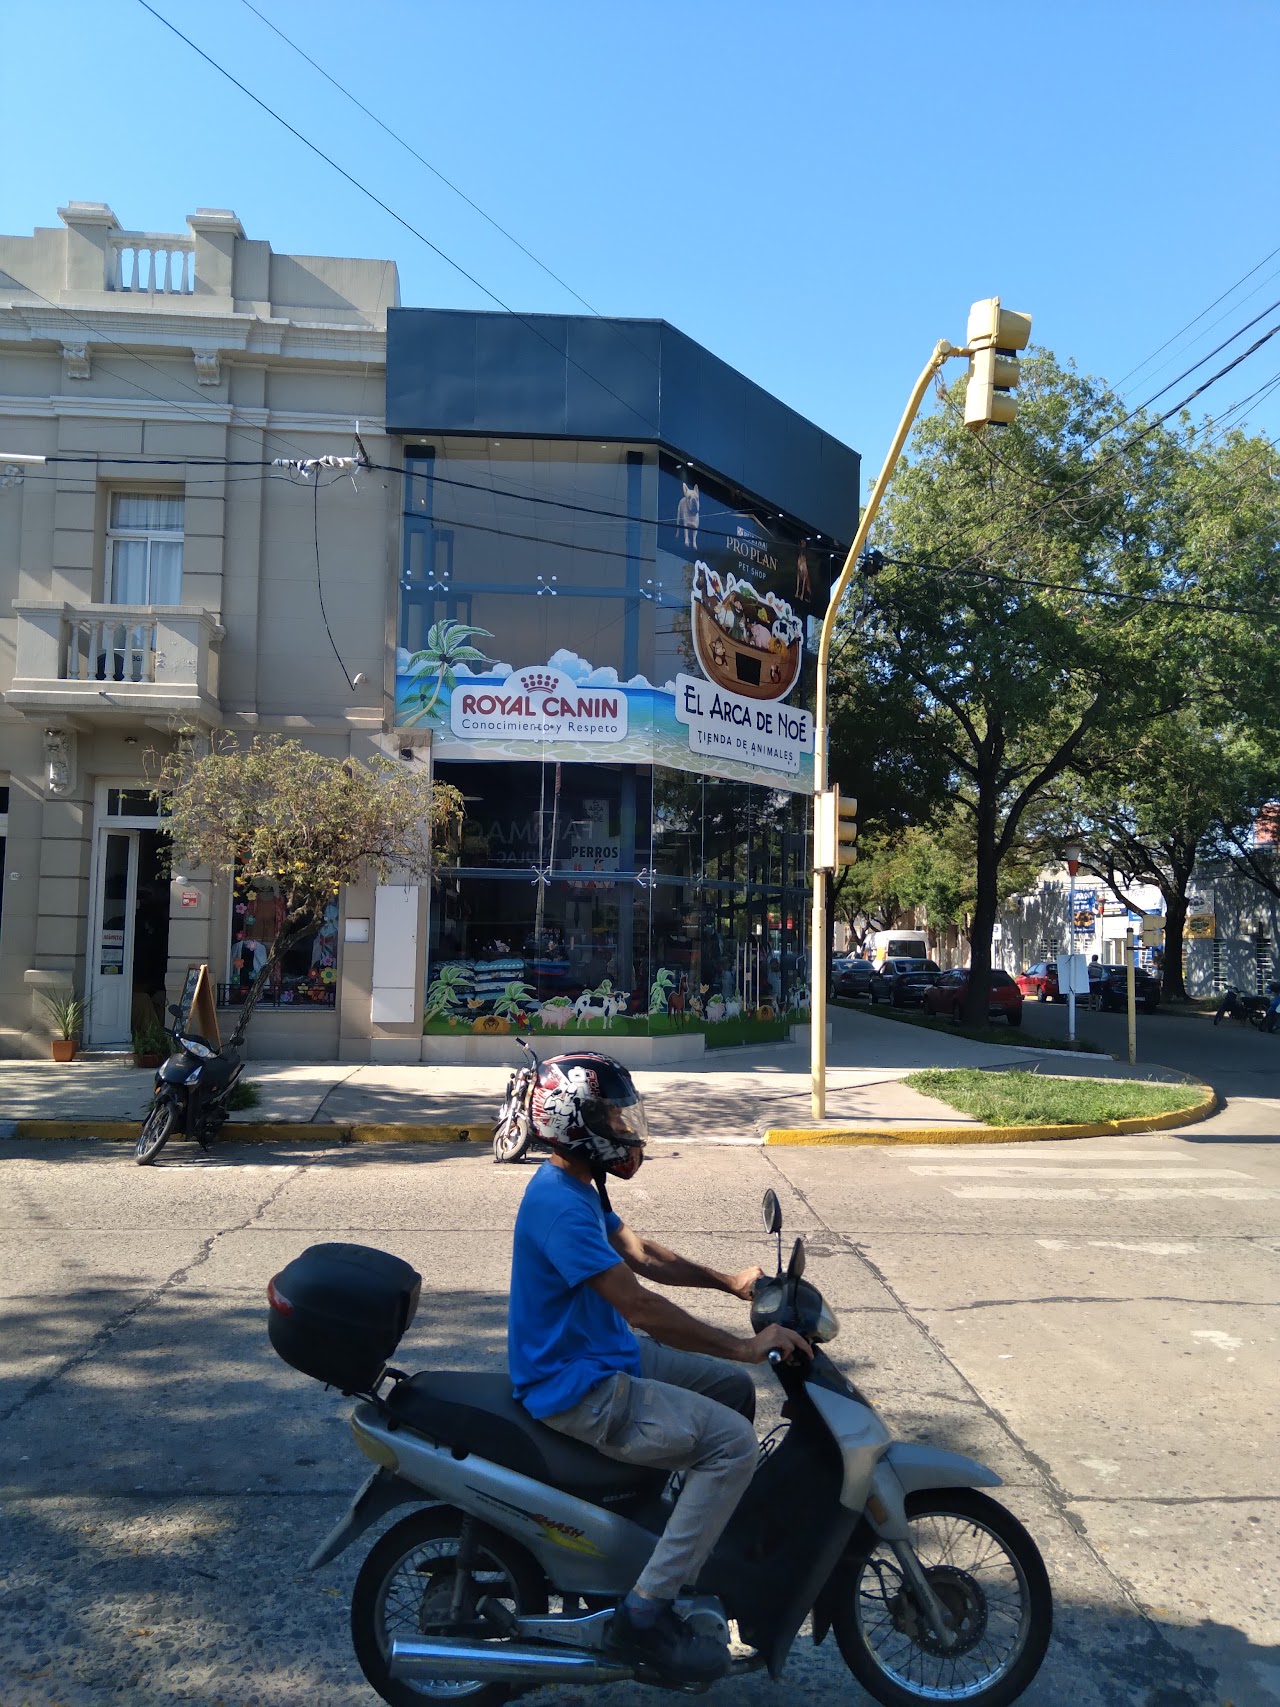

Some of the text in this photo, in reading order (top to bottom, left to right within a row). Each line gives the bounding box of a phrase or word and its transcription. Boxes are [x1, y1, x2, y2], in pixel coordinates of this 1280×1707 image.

[726, 536, 778, 571] PRO PLAN
[738, 561, 767, 579] PET SHOP
[462, 694, 618, 719] ROYAL CANIN
[684, 684, 807, 742] EL ARCA DE NOÉ
[462, 718, 618, 735] Conocimiento y Respeto
[698, 730, 793, 761] TIENDA DE ANIMALES
[571, 846, 619, 859] PERROS
